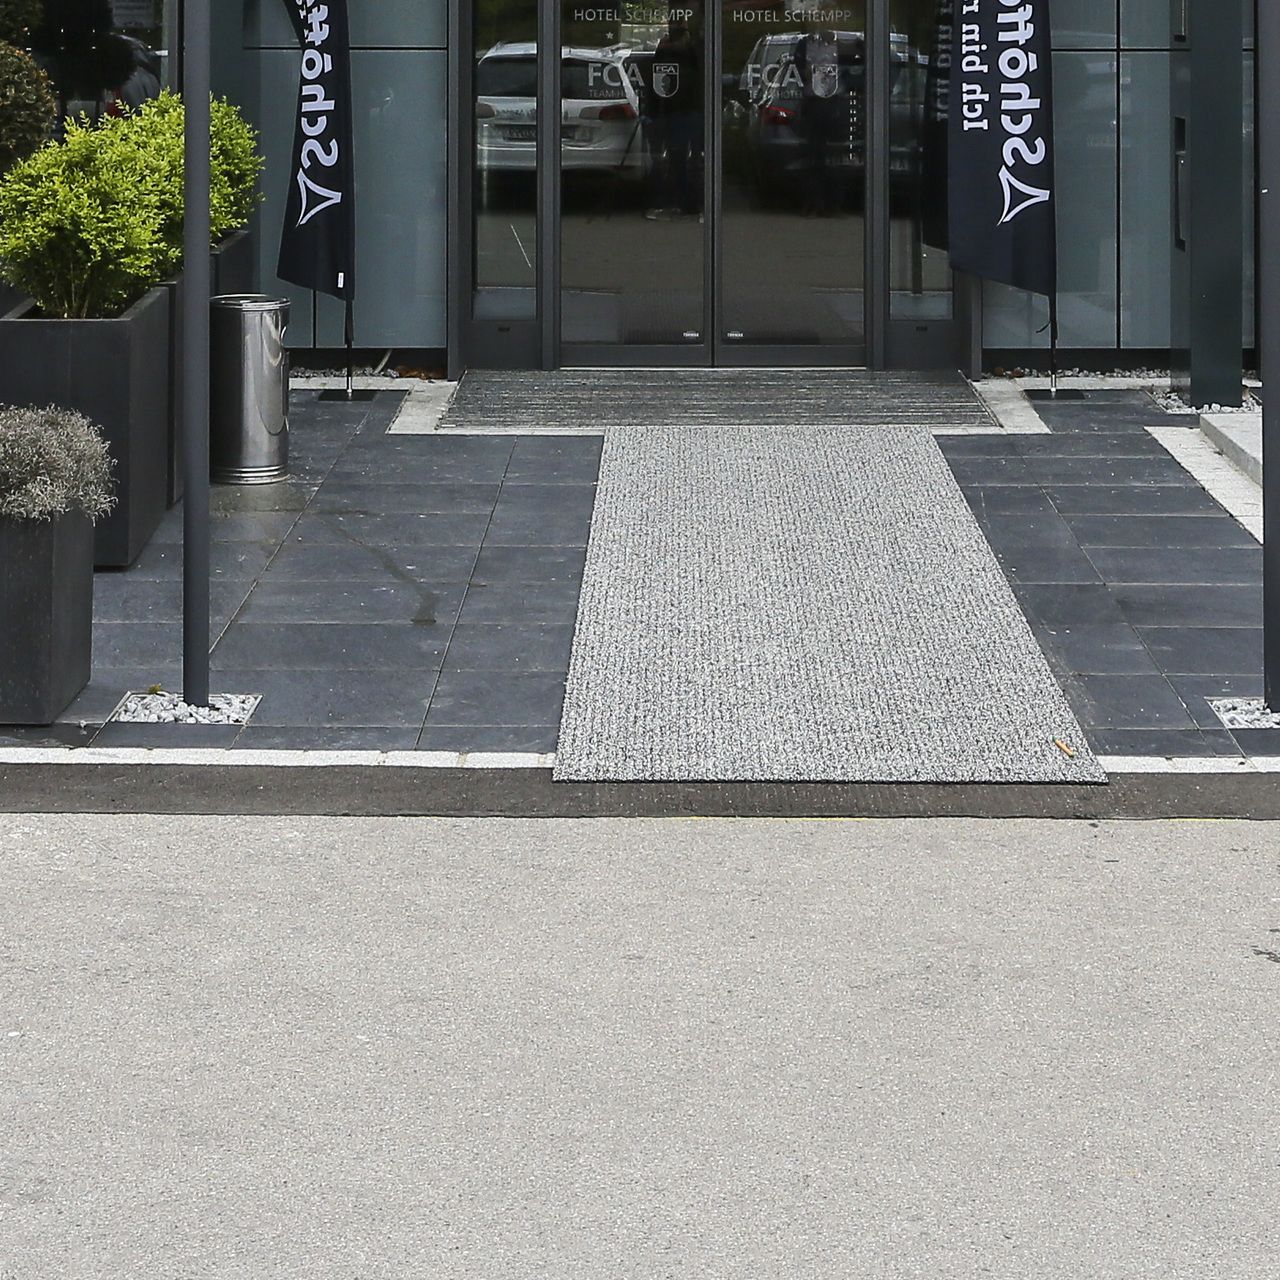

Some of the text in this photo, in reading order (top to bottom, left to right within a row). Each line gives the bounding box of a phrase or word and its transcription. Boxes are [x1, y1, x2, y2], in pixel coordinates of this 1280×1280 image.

[574, 8, 621, 22] HOTEL
[733, 9, 852, 23] HOTEL SCHEMPP
[588, 62, 645, 87] FCA
[747, 63, 804, 88] FCA
